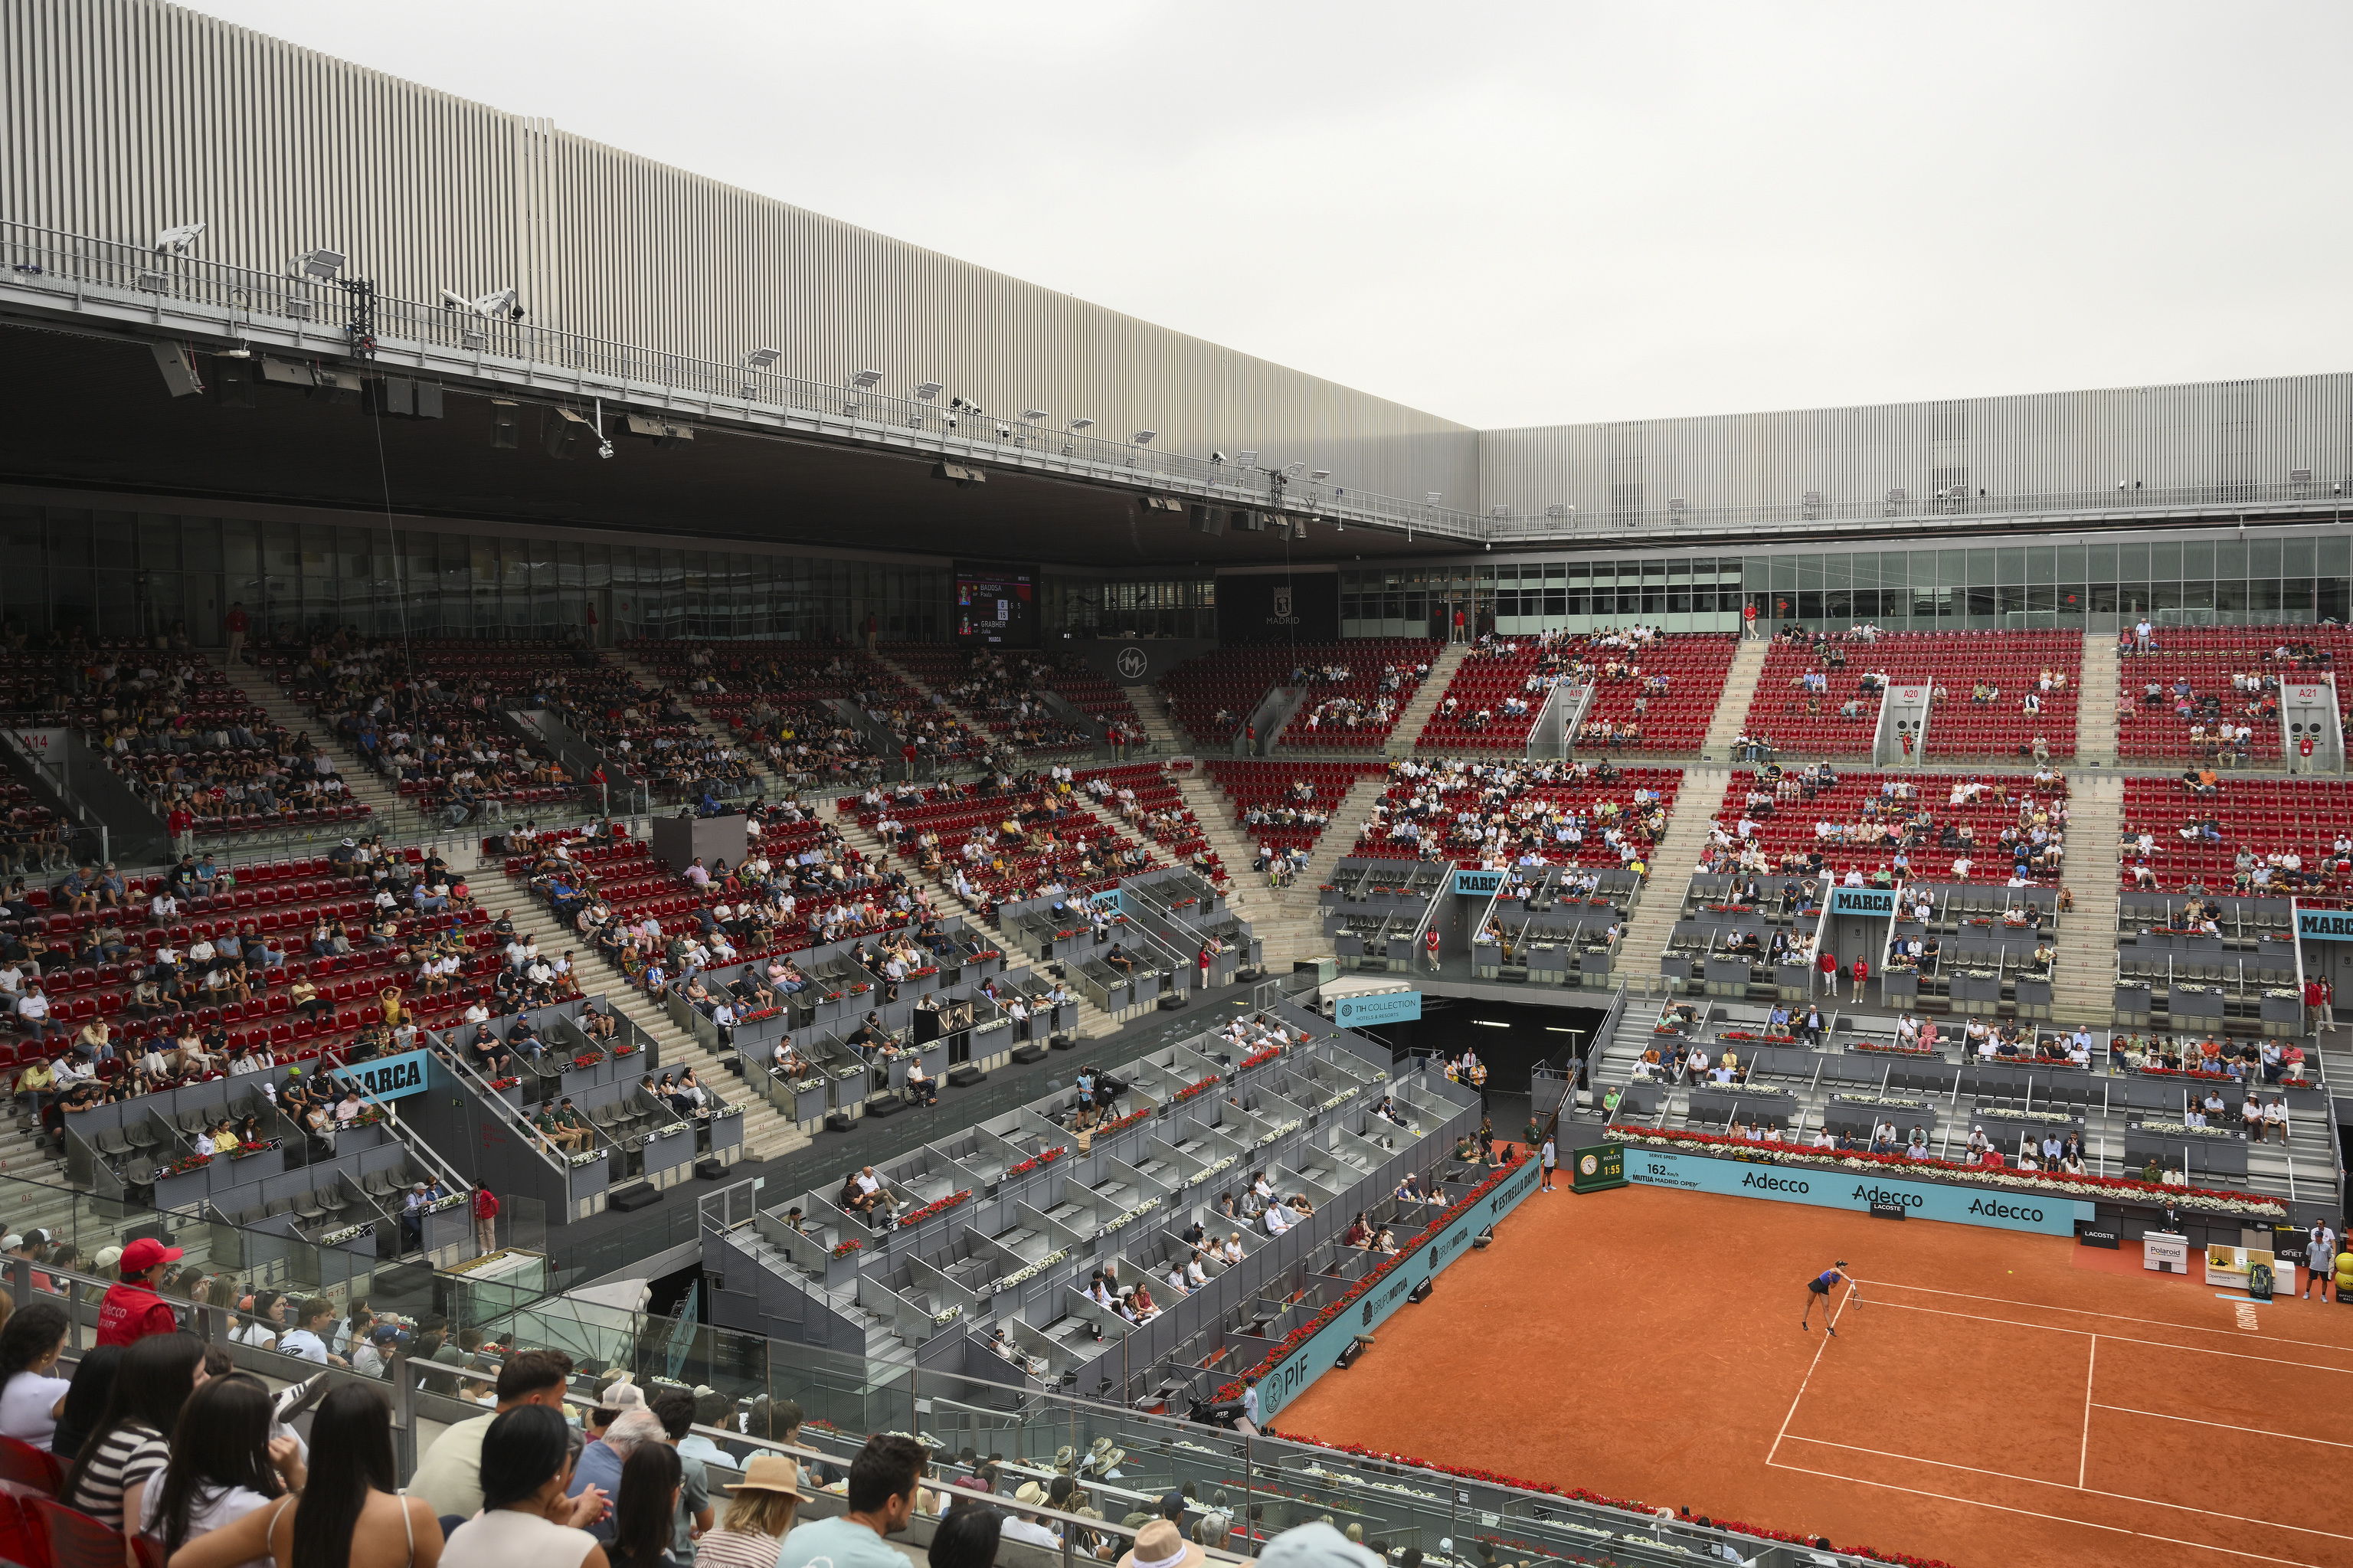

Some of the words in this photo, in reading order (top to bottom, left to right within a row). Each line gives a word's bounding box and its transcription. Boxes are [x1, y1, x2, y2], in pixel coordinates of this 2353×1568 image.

[2299, 689, 2316, 697] A21
[23, 735, 47, 748] A14
[1838, 894, 1893, 912] MARCA
[1368, 1000, 1415, 1011] COLLECTION
[1605, 1164, 1619, 1175] 1:55
[1647, 1164, 1665, 1175] 162
[1633, 1174, 1654, 1183] MUTUA
[1742, 1172, 1809, 1193] Adecco
[1499, 1183, 1523, 1210] ESTRELLA
[1523, 1165, 1540, 1190] DAMM
[21, 1193, 32, 1202] 05
[1852, 1185, 1923, 1207] Adecco
[1968, 1198, 2044, 1222] Adecco
[52, 1227, 62, 1236] 04
[2085, 1231, 2114, 1239] LACOSTE
[2151, 1246, 2180, 1255] Polaroid
[1417, 1278, 1429, 1291] LACOSTE
[100, 1318, 116, 1329] STAFF
[1345, 1340, 1359, 1356] LACOSTE
[1285, 1353, 1308, 1396] PIF
